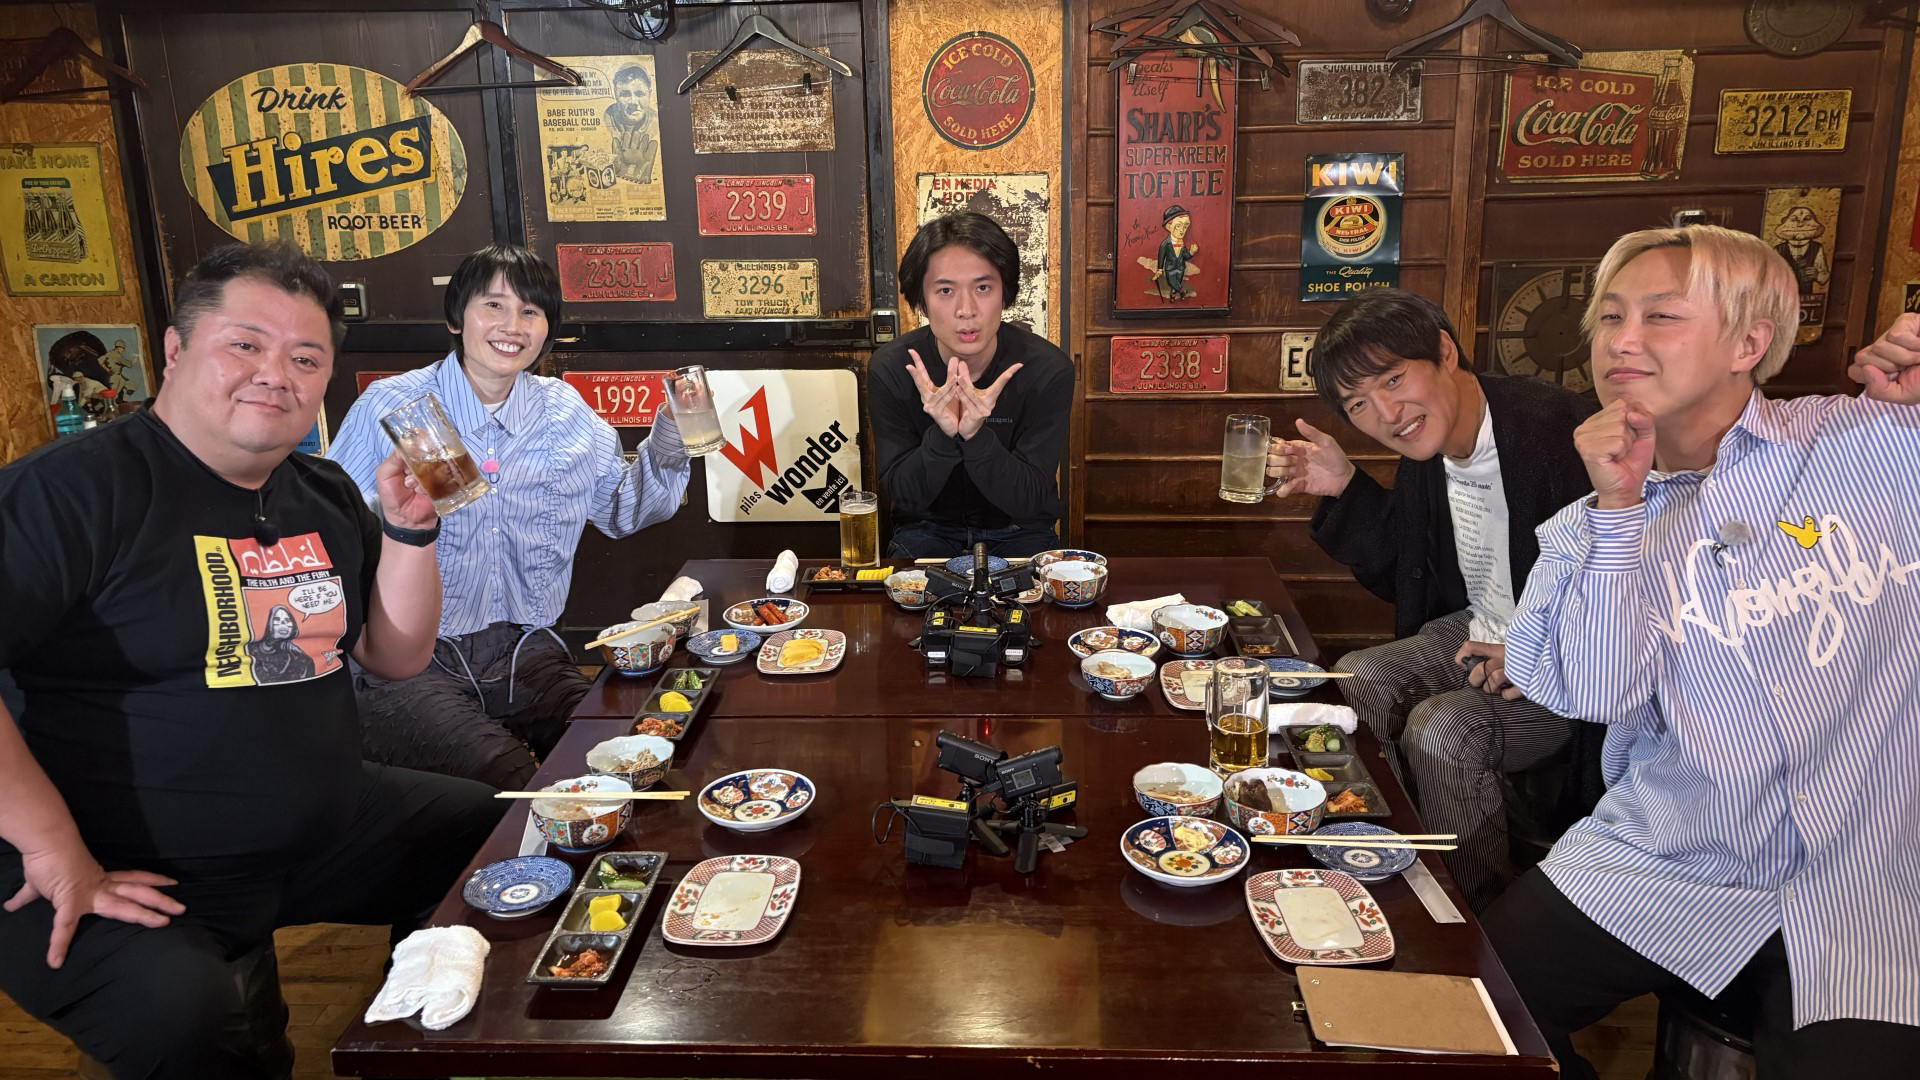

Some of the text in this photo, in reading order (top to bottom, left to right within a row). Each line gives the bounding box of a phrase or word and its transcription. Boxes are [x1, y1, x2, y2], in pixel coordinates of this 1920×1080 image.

[942, 43, 1013, 70] ICE COLD
[1348, 64, 1382, 72] ILLINOIS
[931, 75, 1022, 107] Coca-Cola
[1132, 80, 1170, 103] itself
[1338, 75, 1386, 108] 382
[1536, 74, 1636, 95] ICE COLD
[251, 86, 347, 112] Drink
[547, 108, 595, 117] BABE RUTH'S
[1743, 104, 1840, 136] 3212 PM
[543, 118, 601, 127] BASEBALL CLUB
[943, 113, 1016, 139] SOLD HERE
[1126, 104, 1222, 144] SHARP'S
[1516, 98, 1646, 146] Coca-Cola
[1767, 140, 1803, 148] ILLINOIS
[0, 154, 90, 169] TAKE HOME
[1125, 144, 1228, 167] SUPER-KREEM
[1518, 154, 1632, 168] SOLD HERE
[222, 126, 425, 213] Hires
[1312, 161, 1397, 187] KIWI
[933, 178, 997, 190] EN MEDIA
[1124, 169, 1226, 199] TOFFEE
[727, 190, 809, 220] 2339 J
[1334, 204, 1368, 215] KIWI
[327, 215, 423, 230] ROOT BEER
[1335, 227, 1369, 236] NEUTRAL
[587, 258, 669, 288] 2331 J
[745, 263, 775, 271] ILLINOIS
[1338, 266, 1374, 278] Quality
[24, 273, 105, 287] A CARTON
[710, 275, 721, 294] 2
[737, 274, 784, 294] 3296
[1307, 282, 1340, 292] SHOE
[1140, 340, 1159, 348] LAND
[1170, 339, 1198, 347] LINCOLN
[1140, 350, 1223, 380] 2338 J
[592, 375, 609, 383] LAND
[1155, 382, 1187, 390] ILLINOIS
[593, 385, 651, 414] 1992
[815, 475, 845, 506] en vente ici
[740, 491, 762, 515] piles
[246, 570, 331, 587] THE FILTH AND THE FURY
[951, 582, 967, 590] SONY
[294, 595, 317, 603] HERE
[324, 590, 338, 598] YOU
[302, 587, 314, 596] I'LL
[302, 600, 320, 609] NEED
[205, 552, 242, 678] NEIGHBORHOOD
[973, 753, 995, 765] SONY
[1001, 767, 1015, 775] SONY
